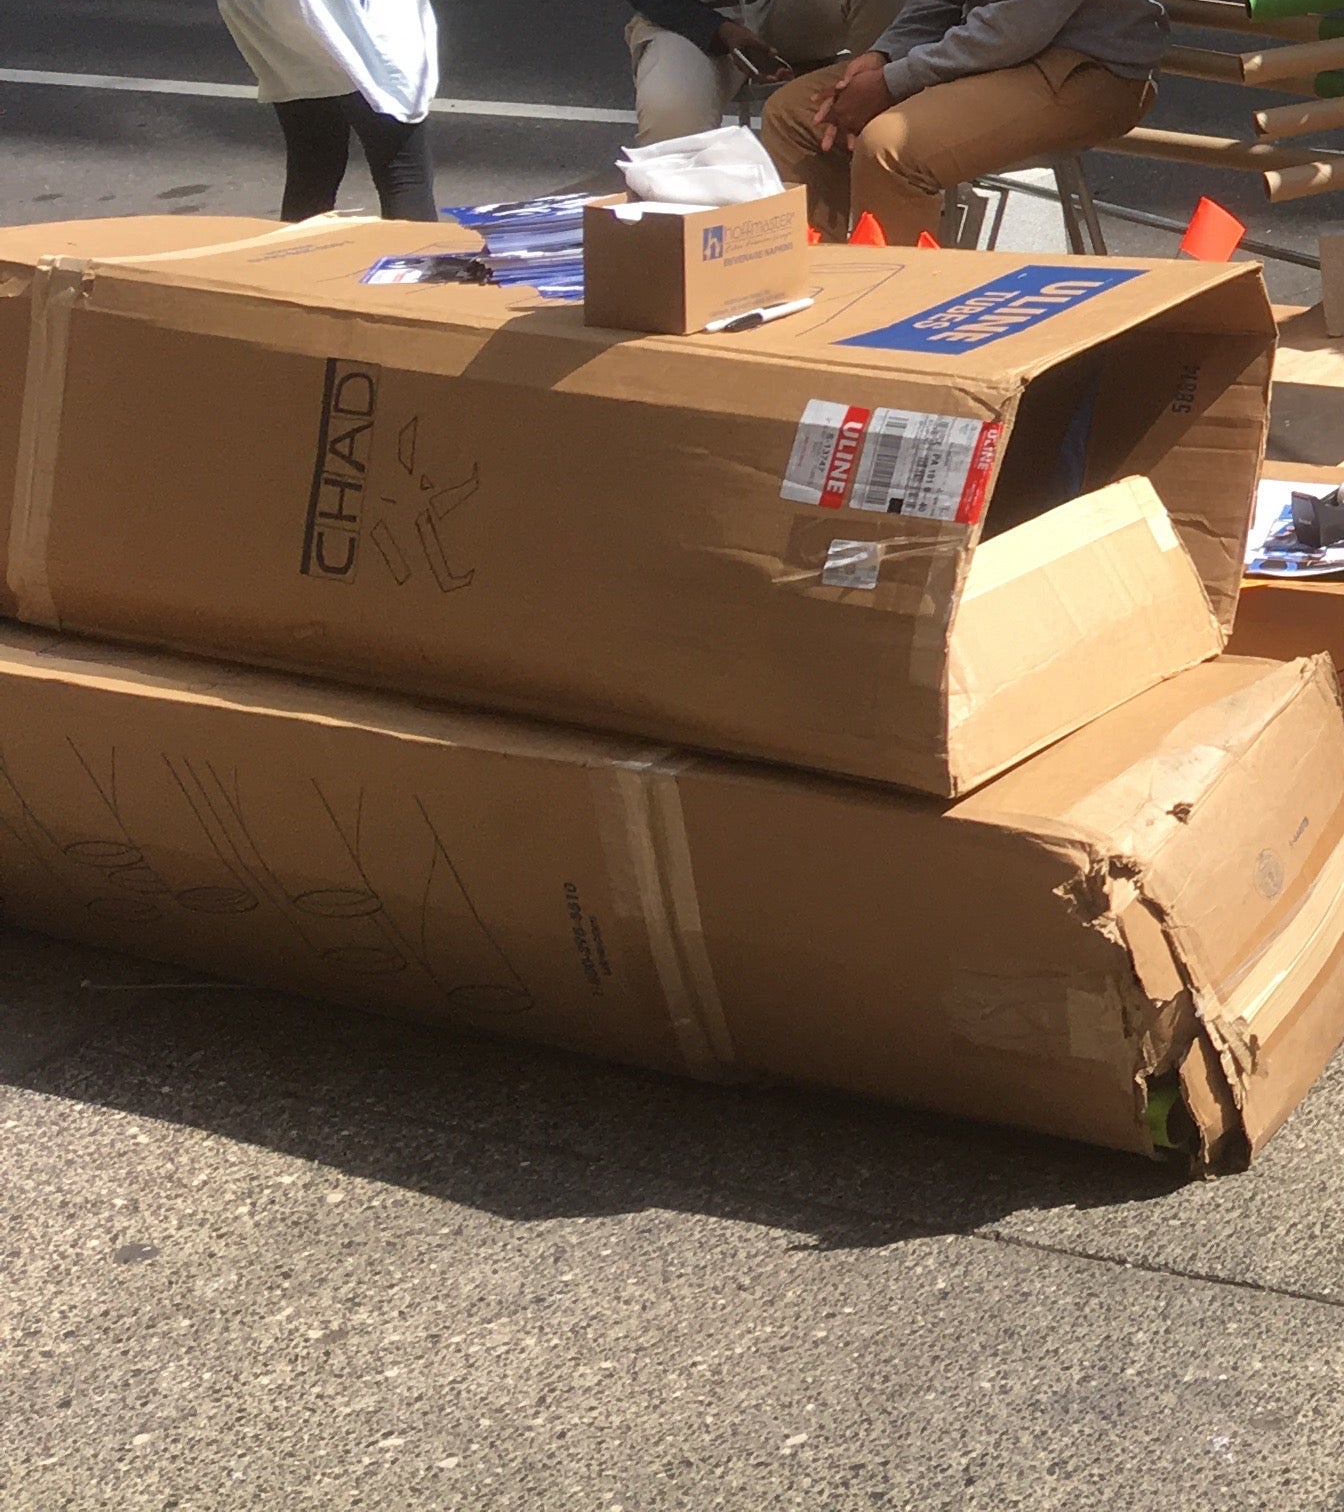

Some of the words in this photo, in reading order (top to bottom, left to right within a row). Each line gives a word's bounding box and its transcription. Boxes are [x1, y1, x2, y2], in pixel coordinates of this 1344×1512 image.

[912, 290, 1016, 330] TUBES
[936, 279, 1106, 342] ULINE
[314, 369, 378, 576] CHAD
[825, 420, 864, 496] ULINE
